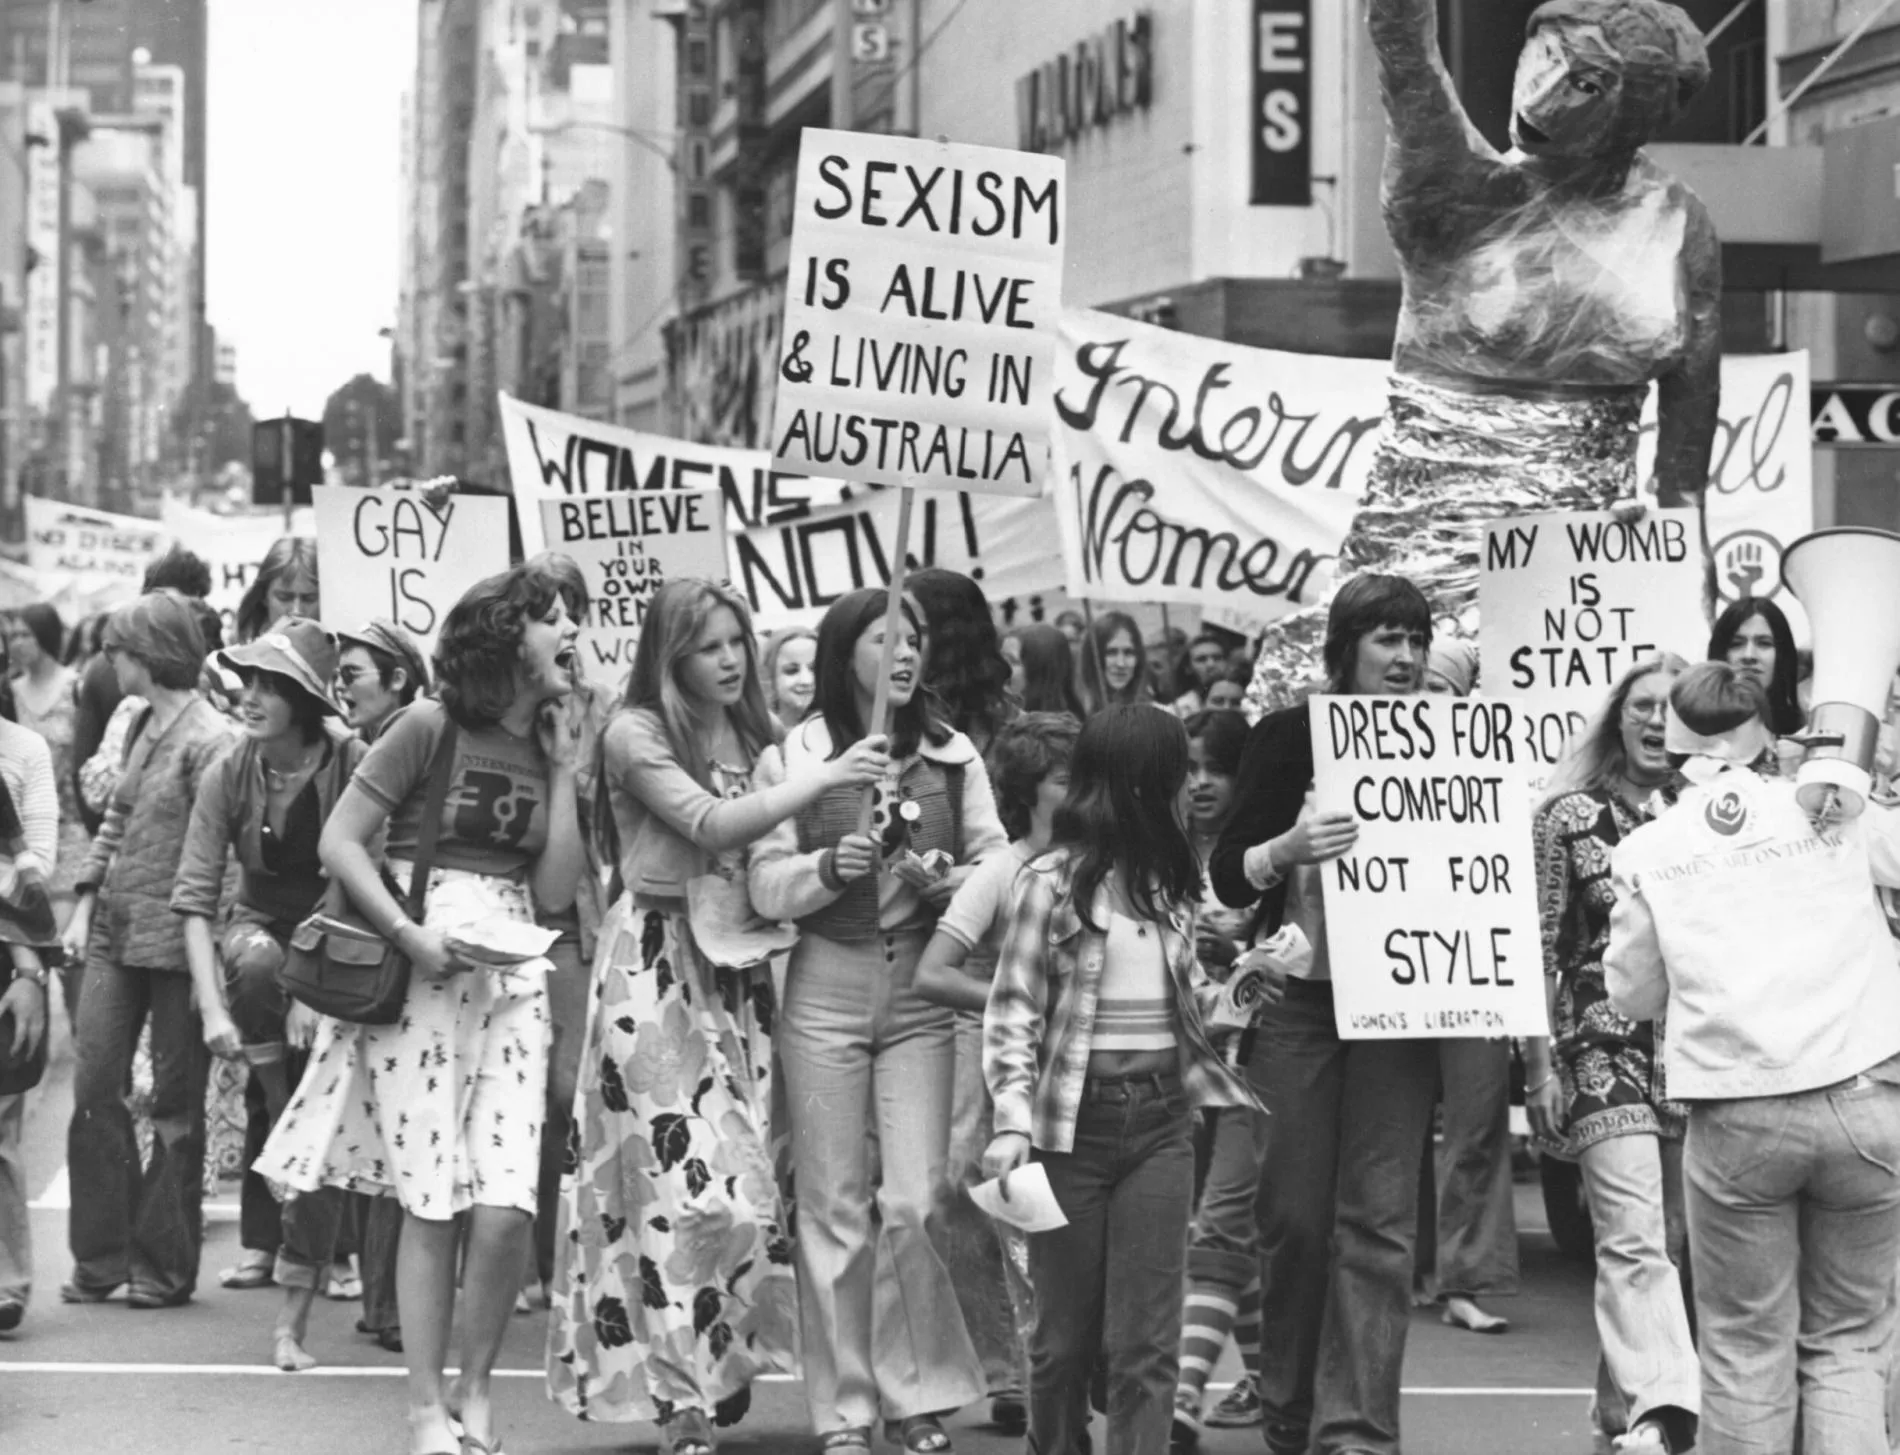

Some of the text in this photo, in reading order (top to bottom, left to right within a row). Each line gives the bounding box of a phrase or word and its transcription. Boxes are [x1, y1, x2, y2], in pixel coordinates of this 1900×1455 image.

[814, 155, 1058, 245] SEXISM
[804, 256, 1035, 329] IS ALIVE
[782, 330, 1033, 406] & LIVING IN
[776, 408, 1032, 484] AUSTRALIA
[354, 495, 455, 562] GAY
[560, 494, 710, 542] BELIEVE
[1488, 518, 1687, 572] MY WOMB
[599, 556, 663, 578] YOUR
[618, 540, 644, 557] IN
[391, 566, 436, 636] IS
[1570, 573, 1602, 607] IS
[1544, 607, 1635, 641] NOT
[1329, 700, 1514, 763] DRESS FOR
[1354, 775, 1503, 823] COMFORT
[1337, 854, 1512, 894] NOT FOR
[1385, 928, 1514, 986] STYLE
[1351, 1009, 1504, 1032] WOMEN'S LIBERATION
